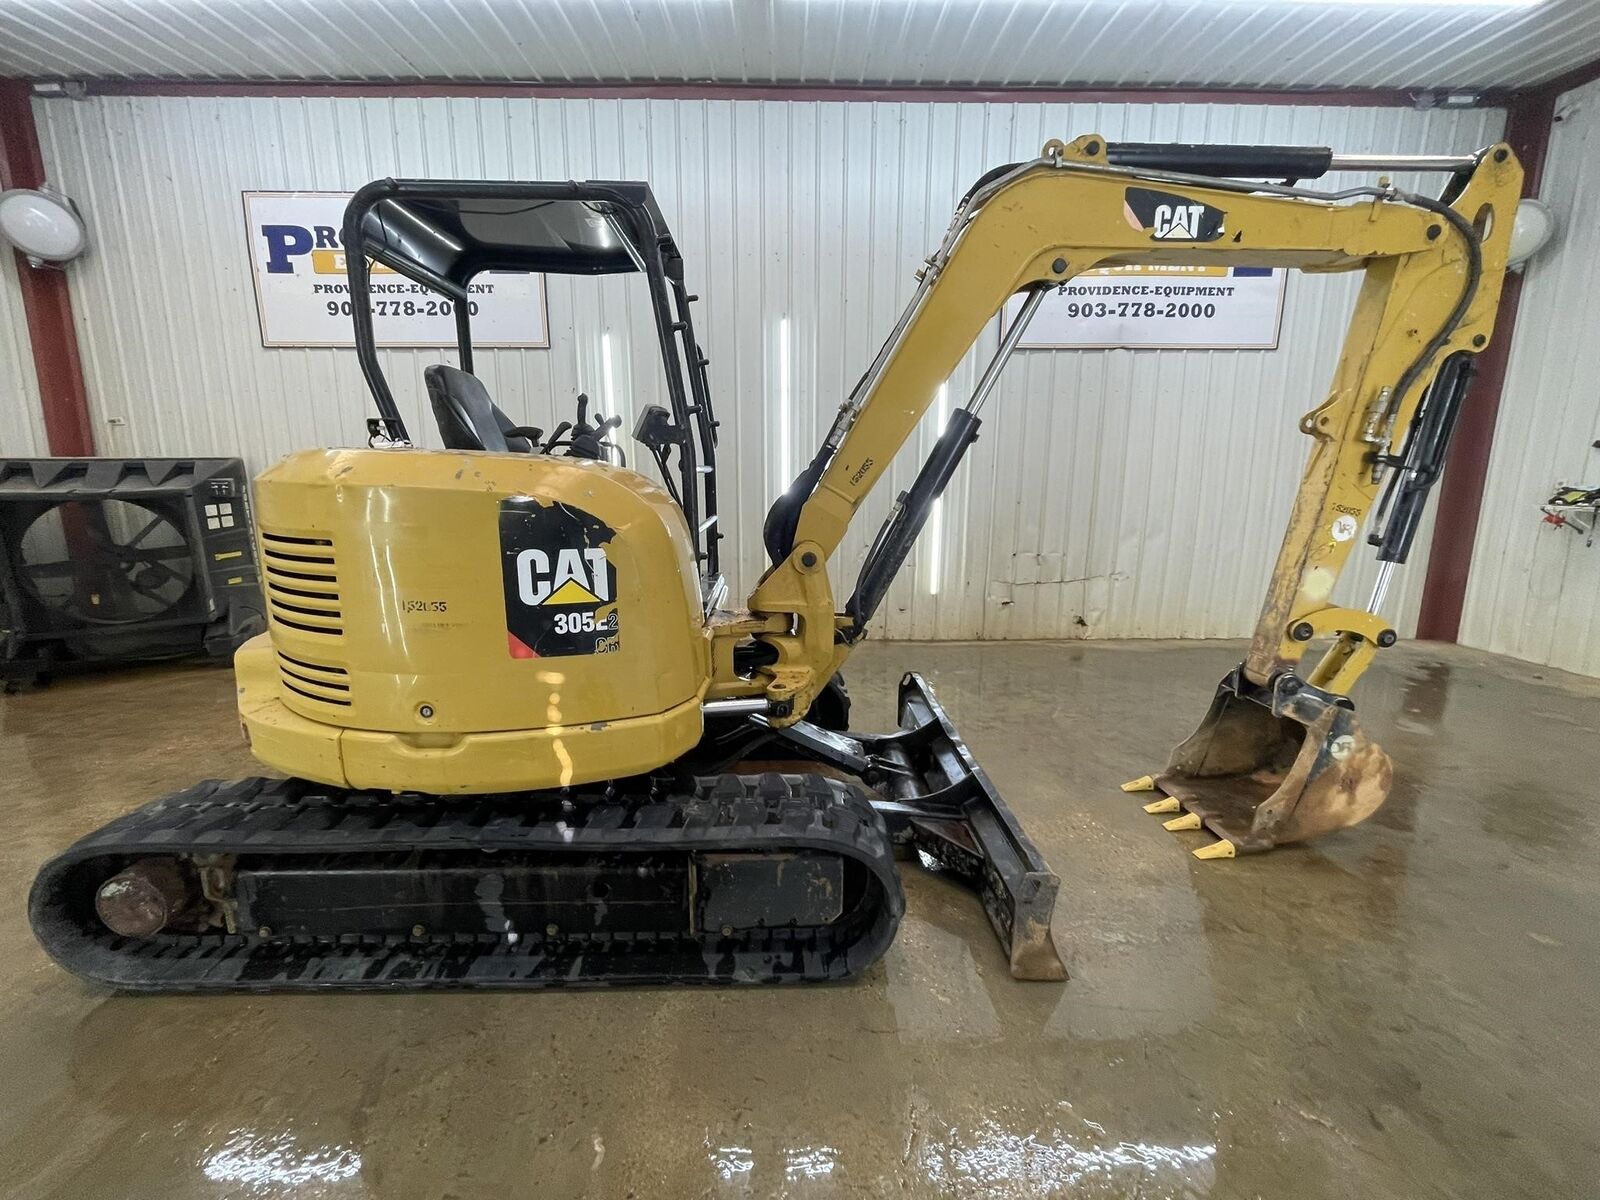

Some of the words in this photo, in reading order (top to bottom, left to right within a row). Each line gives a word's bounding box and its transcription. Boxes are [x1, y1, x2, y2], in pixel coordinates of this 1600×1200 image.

[1154, 205, 1205, 239] CAT
[1057, 285, 1235, 298] PROVIDENCE-EQUIPMENT
[326, 300, 479, 316] 90-778-200
[1067, 303, 1216, 318] 903-778-2000
[517, 548, 609, 605] CAT
